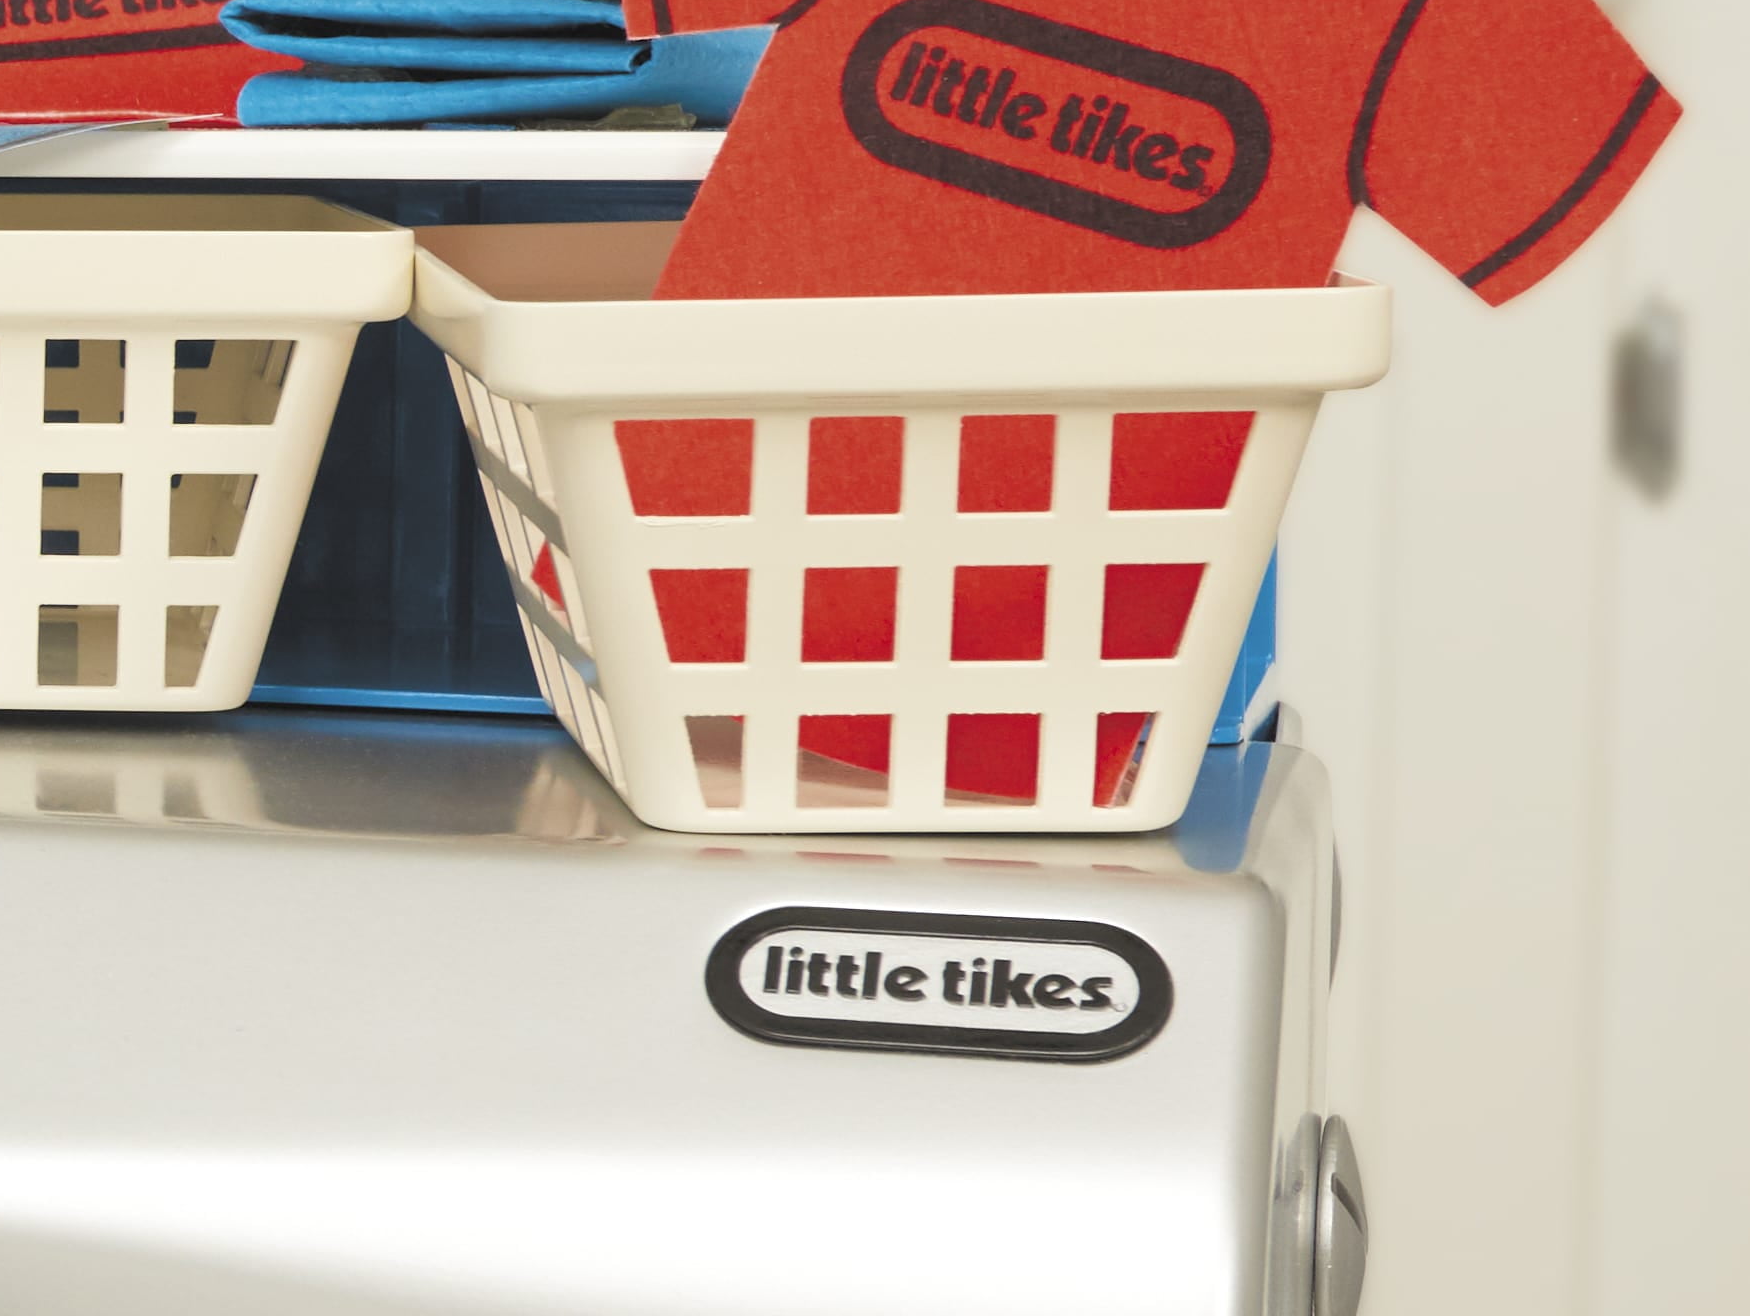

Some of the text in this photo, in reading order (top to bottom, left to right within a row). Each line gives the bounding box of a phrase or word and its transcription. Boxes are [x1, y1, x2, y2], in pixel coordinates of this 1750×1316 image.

[889, 41, 1215, 192] little tikes
[762, 945, 1113, 1011] little tikes
